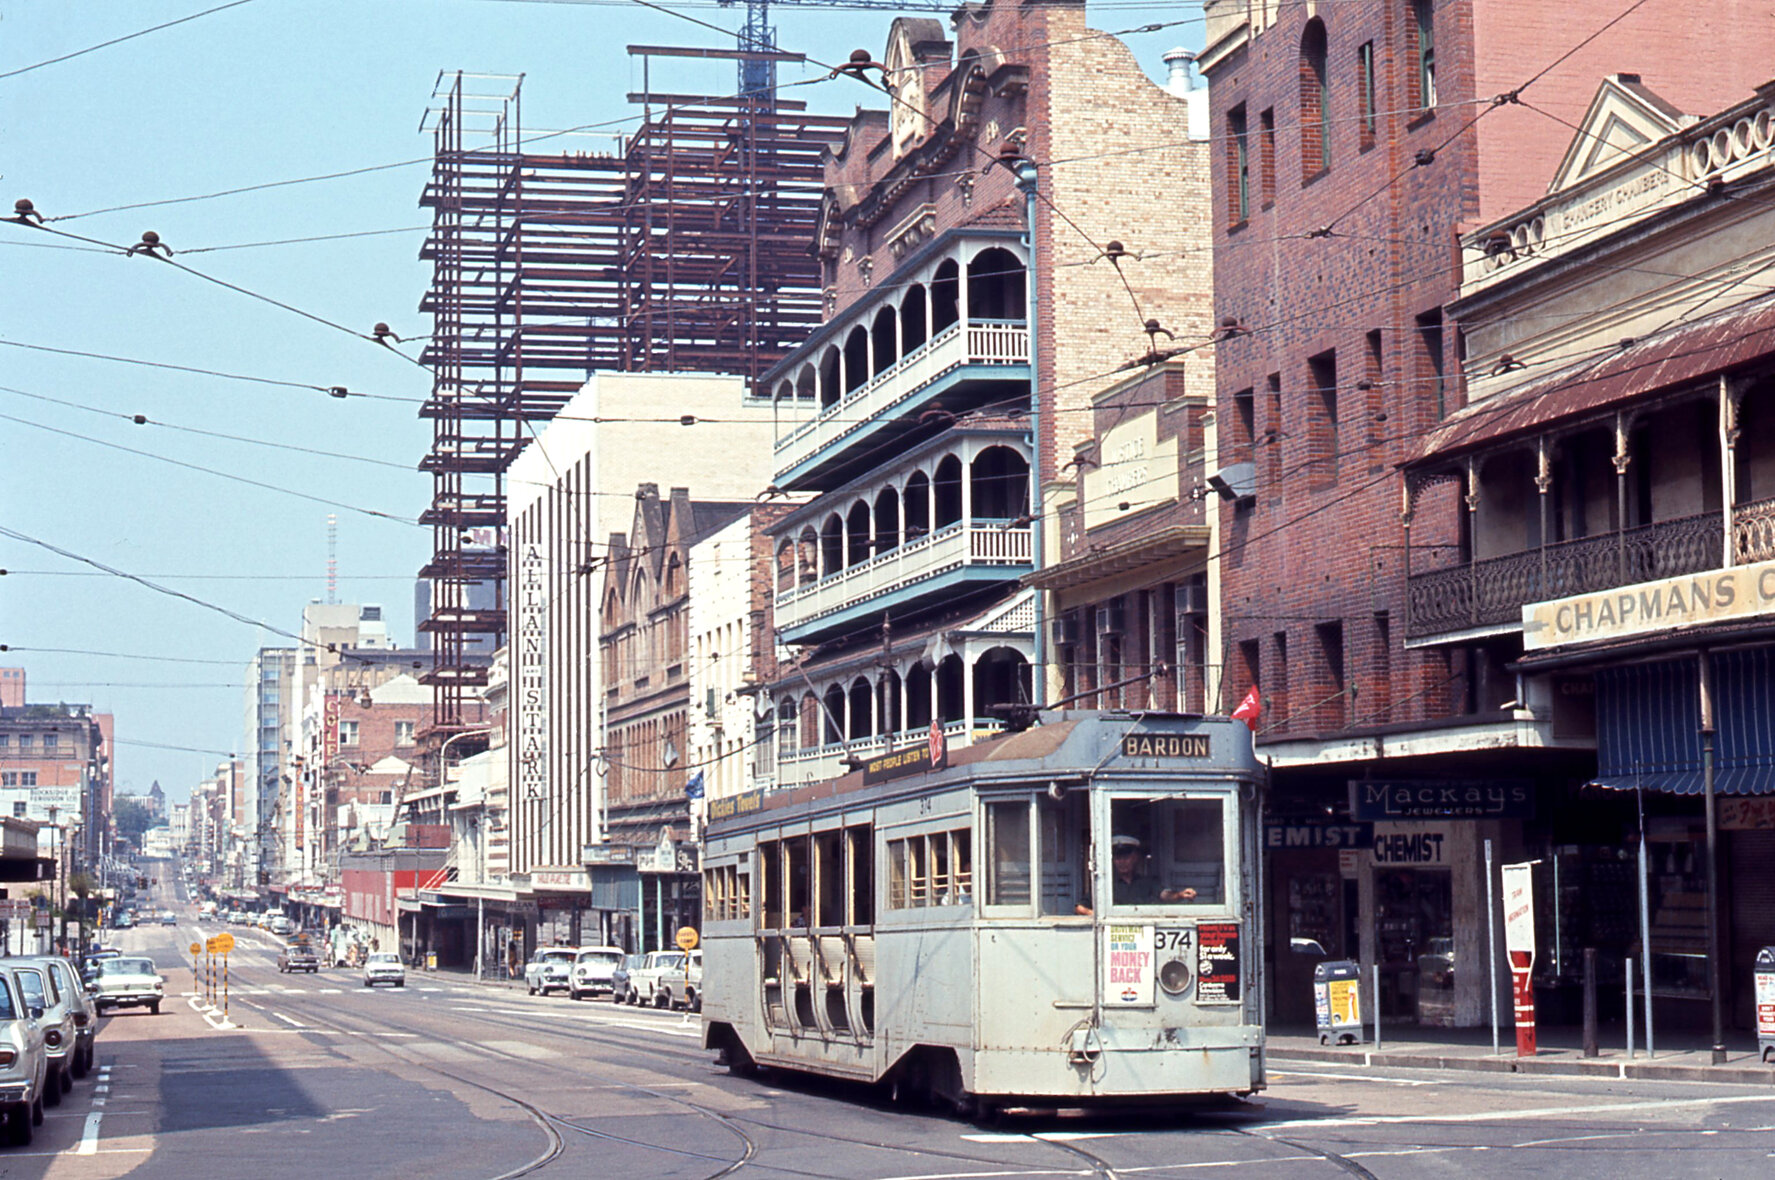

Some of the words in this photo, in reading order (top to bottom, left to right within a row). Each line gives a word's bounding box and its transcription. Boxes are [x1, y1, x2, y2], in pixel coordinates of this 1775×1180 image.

[1563, 191, 1614, 230] CHANCERY
[1616, 171, 1669, 205] CHAMBERS
[526, 546, 539, 652] ALLAN
[1555, 575, 1735, 634] CHAPMANS
[526, 690, 539, 798] STARK
[1126, 736, 1209, 757] BARDON
[883, 755, 901, 769] PEOPLE
[903, 750, 920, 765] LISTEN
[921, 747, 929, 759] TO
[737, 790, 760, 813] Towels
[1404, 805, 1483, 816] JEWELLERS
[1374, 833, 1444, 863] CHEMIST
[1154, 931, 1192, 951] 374
[1200, 944, 1210, 953] for
[1211, 944, 1227, 954] only
[1110, 952, 1150, 967] MONEY
[1110, 968, 1141, 983] BACK
